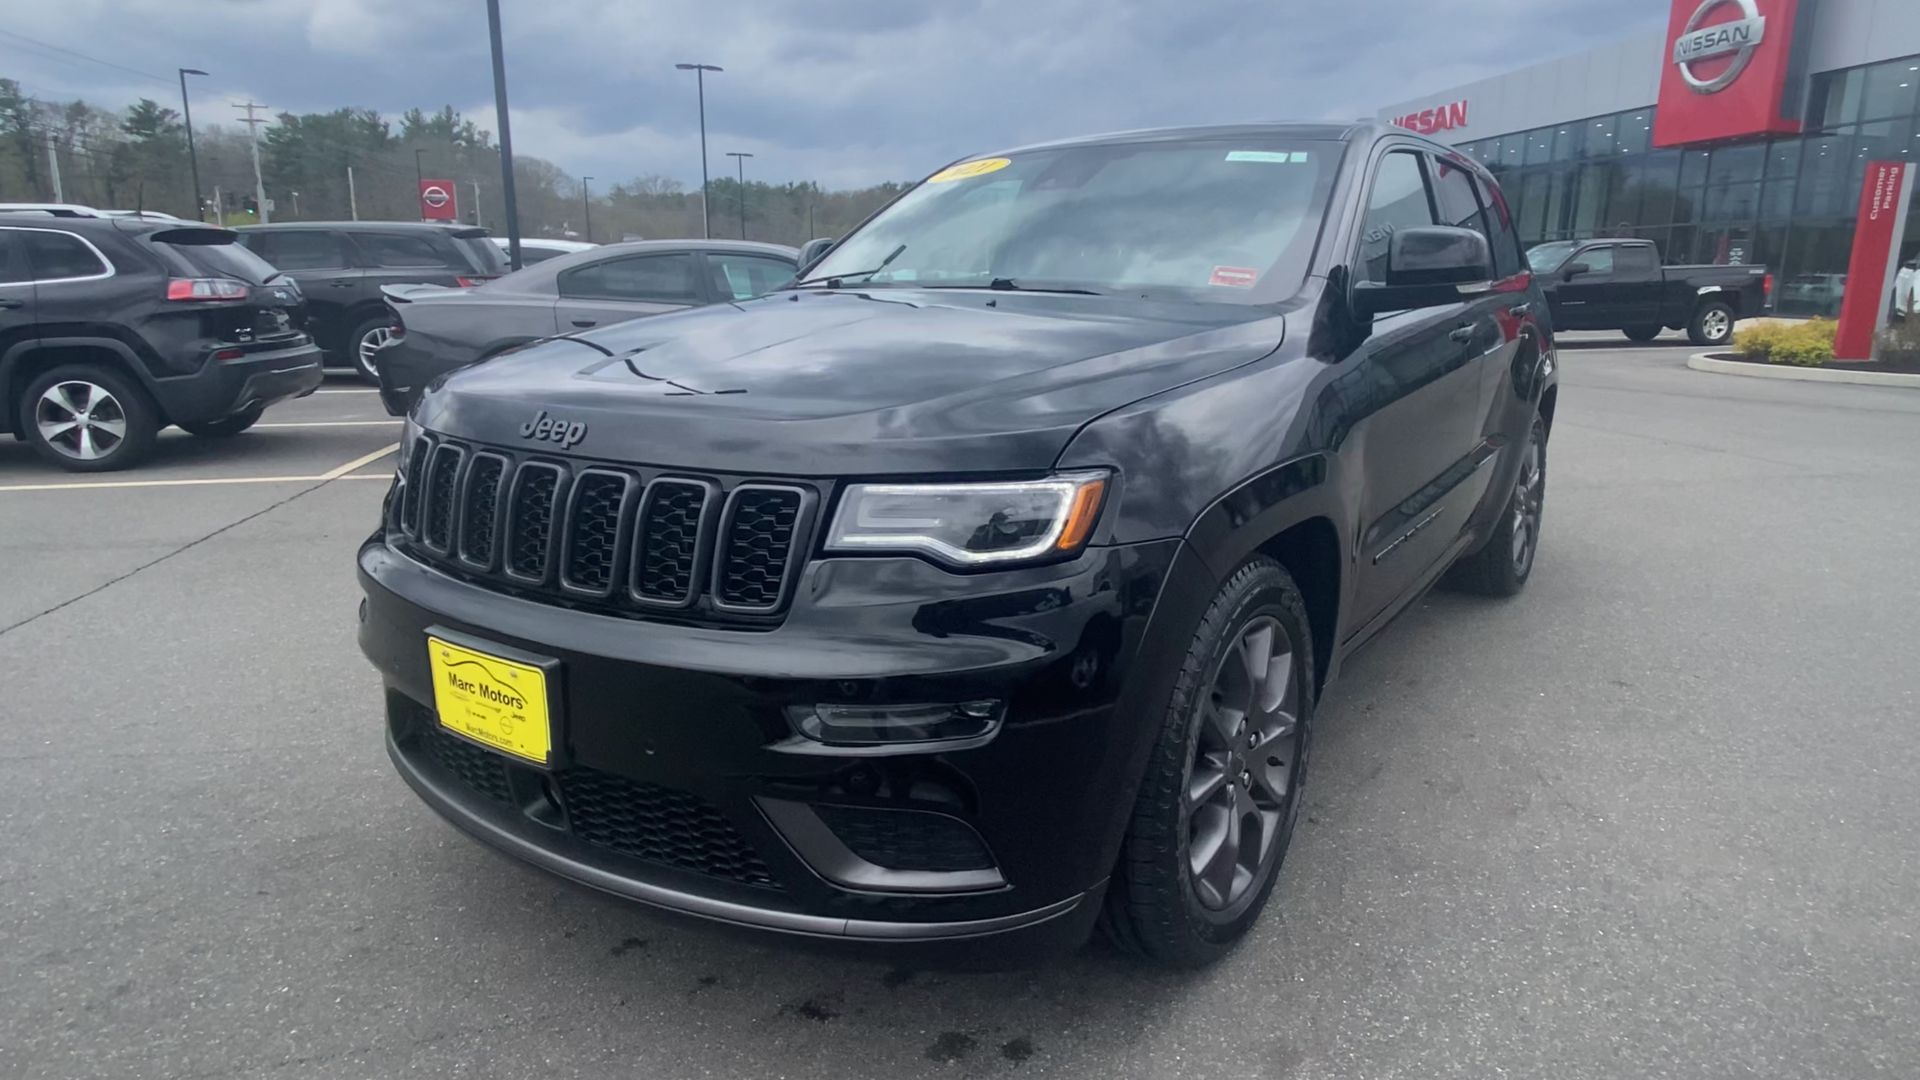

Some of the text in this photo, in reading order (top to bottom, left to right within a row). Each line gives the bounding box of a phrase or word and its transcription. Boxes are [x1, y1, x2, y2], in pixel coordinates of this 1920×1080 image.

[1680, 25, 1750, 54] NISSAN
[1870, 167, 1886, 220] Customer
[1883, 167, 1898, 209] Parking
[520, 410, 588, 450] Jeep
[449, 671, 476, 695] Marc
[479, 683, 524, 710] Motors
